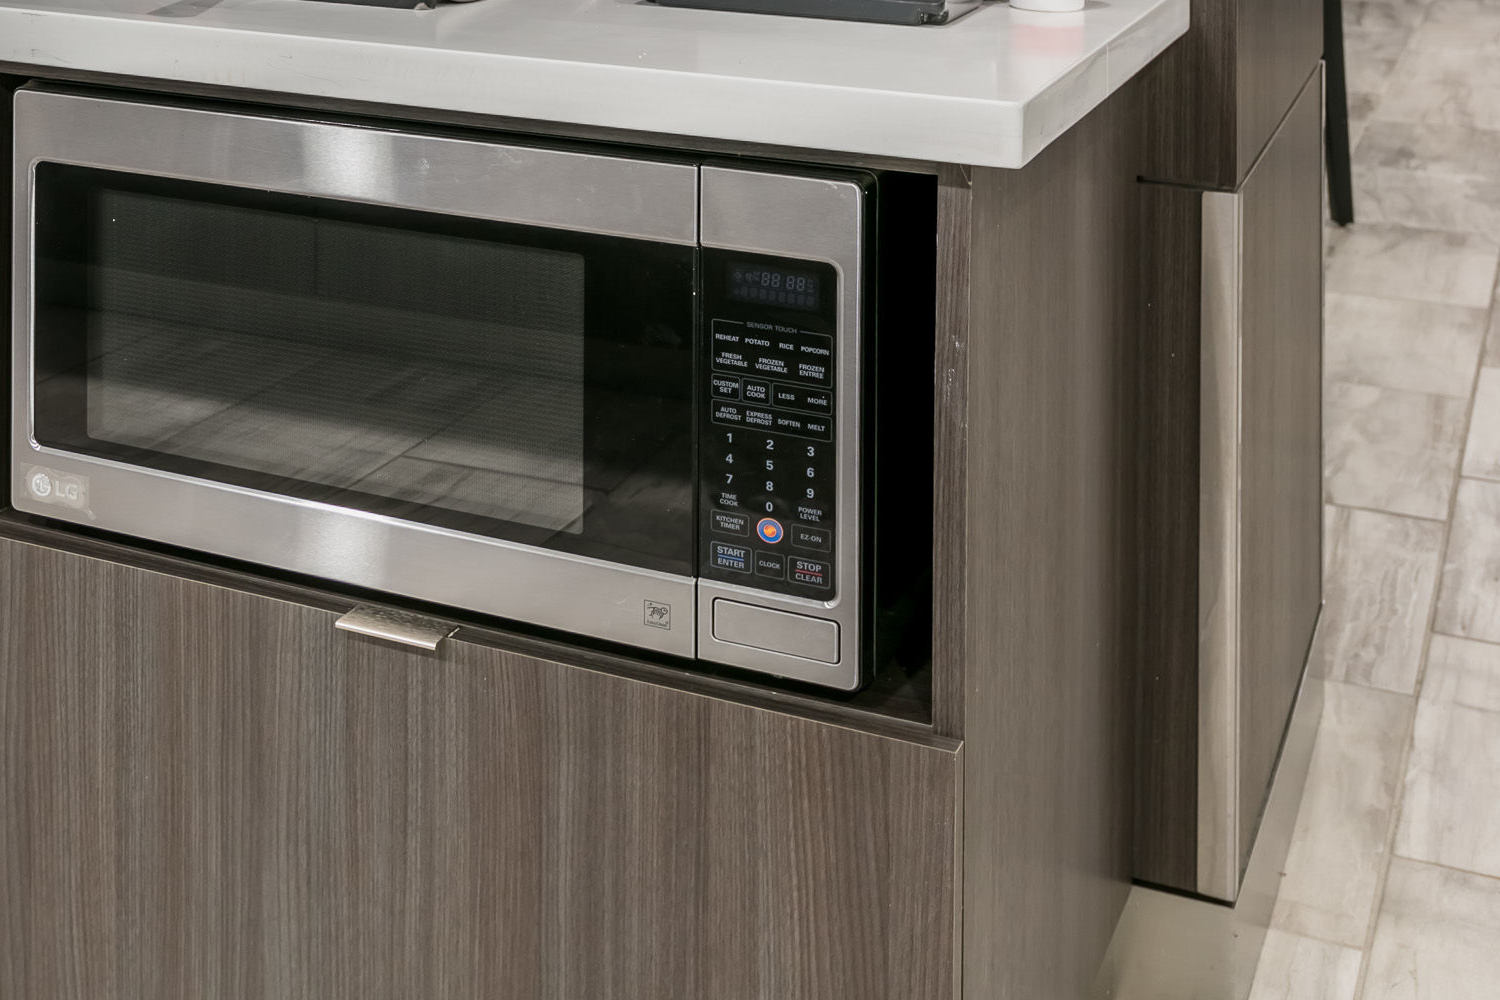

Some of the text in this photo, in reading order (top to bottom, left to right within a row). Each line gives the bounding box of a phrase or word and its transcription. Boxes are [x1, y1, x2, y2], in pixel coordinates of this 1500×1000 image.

[747, 322, 773, 330] SENSOR
[716, 334, 739, 342] REHEAT
[745, 338, 770, 346] POTATO
[801, 346, 829, 355] POPCORN
[721, 352, 742, 360] FRESH
[716, 357, 748, 368] VEGETABLE
[759, 358, 784, 366] FROZEN
[755, 363, 788, 373] VEGETABLE
[799, 364, 824, 372] FROZEN
[713, 380, 738, 388] CUSTOM
[808, 397, 827, 405] MORE
[716, 412, 741, 420] DEFROST
[746, 411, 772, 419] EXPRESS
[746, 417, 772, 425] DEFROST
[778, 419, 800, 427] SOFTEN
[808, 424, 825, 432] MELT
[727, 433, 733, 443] 1
[766, 440, 774, 450] 2
[807, 447, 814, 457] 3
[726, 454, 733, 463] 4
[766, 461, 773, 470] 5
[807, 468, 814, 478] 6
[726, 474, 733, 484] 7
[766, 481, 773, 491] 8
[807, 489, 814, 498] 9
[766, 502, 773, 511] 0
[798, 507, 822, 516] POWER
[716, 516, 744, 525] KITCHEN
[800, 514, 820, 522] LEVEL
[720, 522, 741, 530] TIMER
[801, 534, 822, 542] EZ-ON
[717, 546, 745, 558] START
[717, 558, 744, 569] ENTER
[759, 561, 780, 569] CLOCK
[796, 562, 822, 572] STOP
[796, 573, 822, 584] CLEAR
